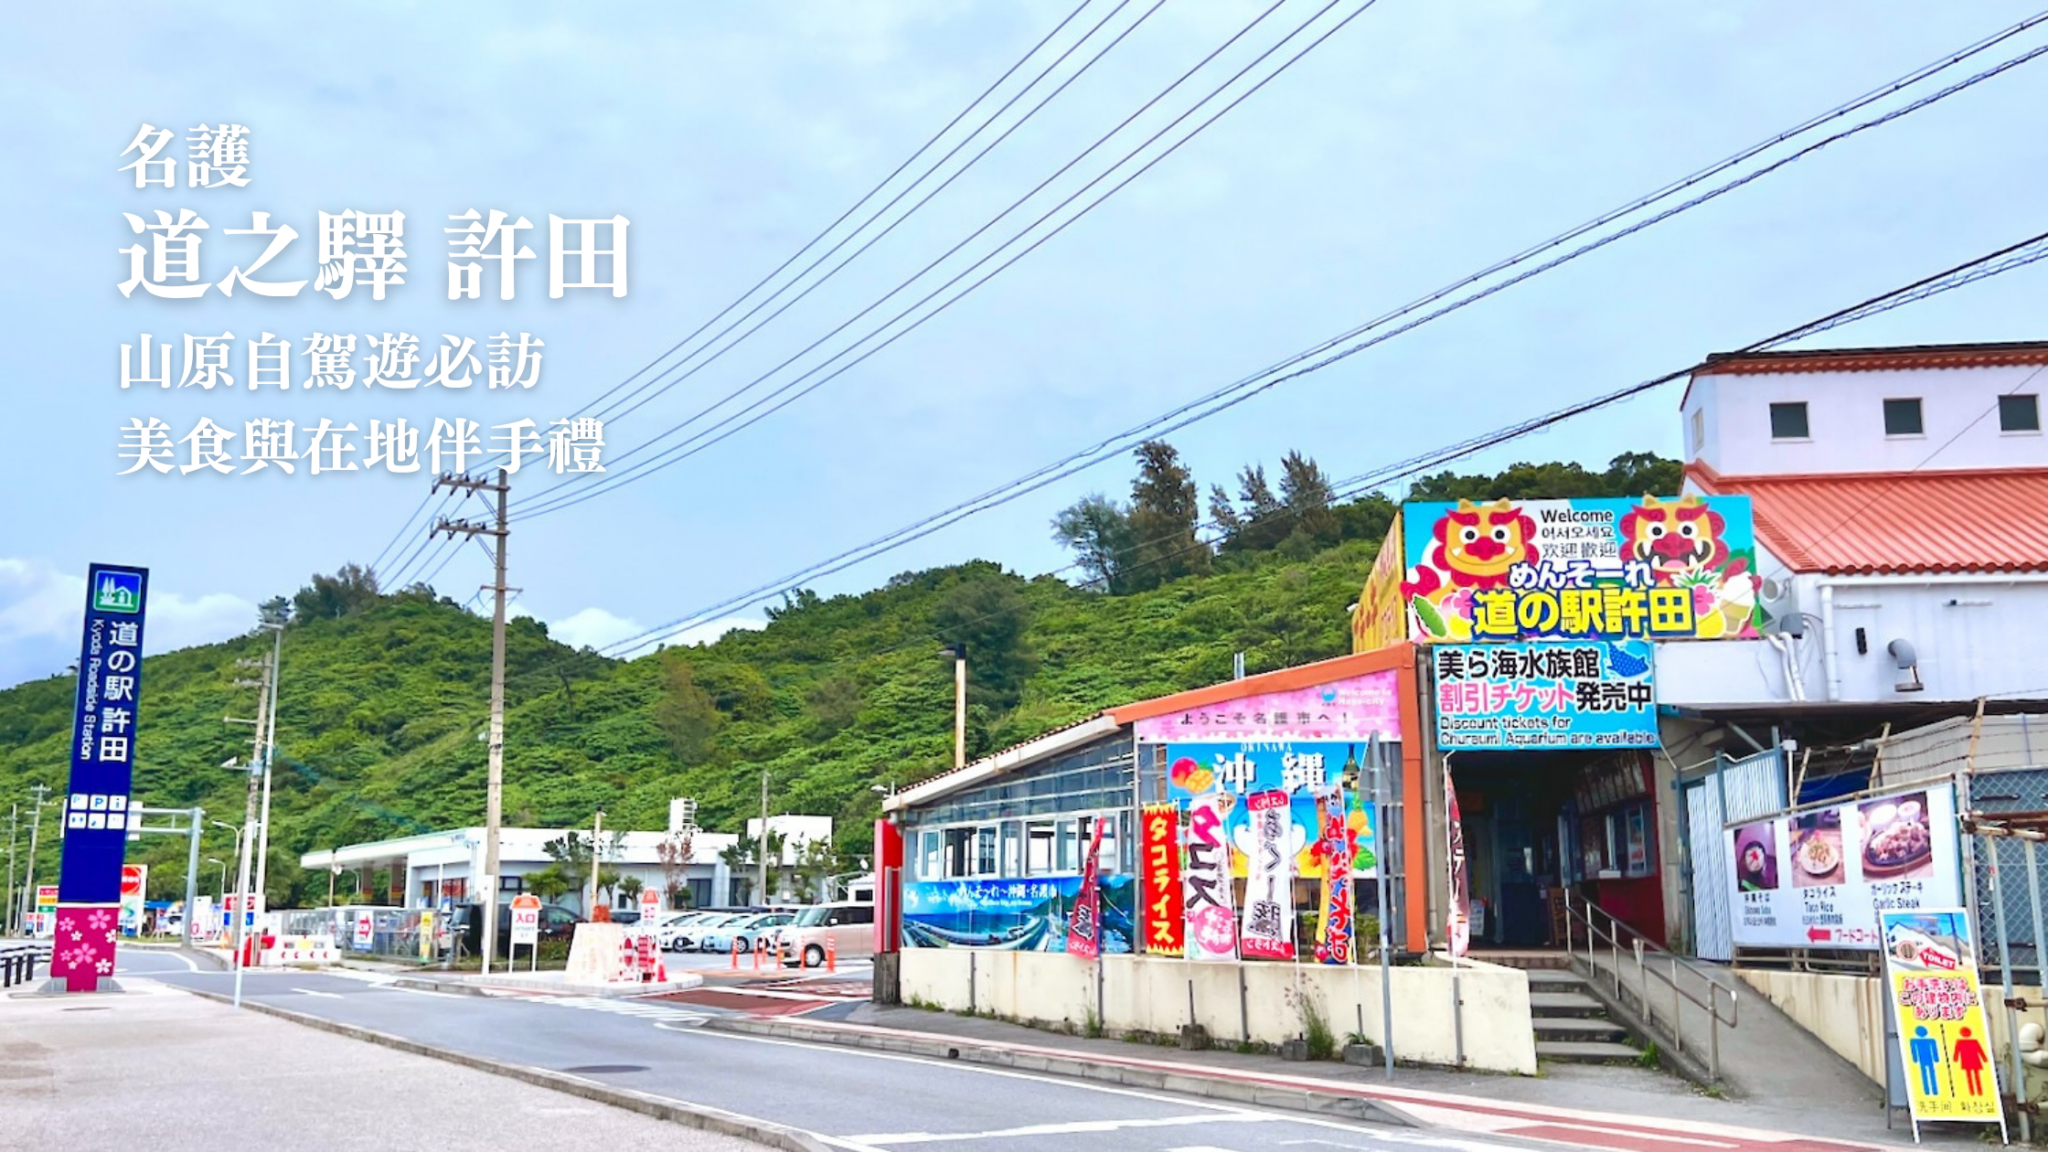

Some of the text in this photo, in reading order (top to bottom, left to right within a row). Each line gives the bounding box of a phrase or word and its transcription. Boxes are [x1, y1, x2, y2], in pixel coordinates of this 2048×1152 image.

[1540, 508, 1613, 523] Welcome
[1541, 526, 1615, 540] 어서오세요
[1509, 560, 1655, 588] めんそーれ
[1475, 589, 1693, 635] 道の駅許田
[1439, 649, 1600, 679] 美ら海水族館
[80, 619, 105, 760] Kyoda Roadside Station
[99, 621, 139, 762] 道の駅 許田
[1338, 688, 1379, 697] Welcome
[1439, 681, 1653, 712] 割引チケット発売中
[1440, 716, 1571, 730] Discount tickets for
[1240, 742, 1293, 752] OKINAWA
[1505, 732, 1567, 748] Aquarium
[1570, 734, 1592, 744] are
[1595, 731, 1655, 744] available
[1213, 752, 1326, 795] 沖縄
[1150, 816, 1175, 944] タコライス
[1803, 886, 1836, 899] タコライス
[1805, 902, 1819, 913] Taco
[1873, 897, 1920, 909] Garlic Steak
[515, 912, 536, 924] 入口
[1835, 928, 1878, 945] フードコート
[1923, 952, 1955, 969] TOILET
[1913, 1006, 1966, 1020] あります
